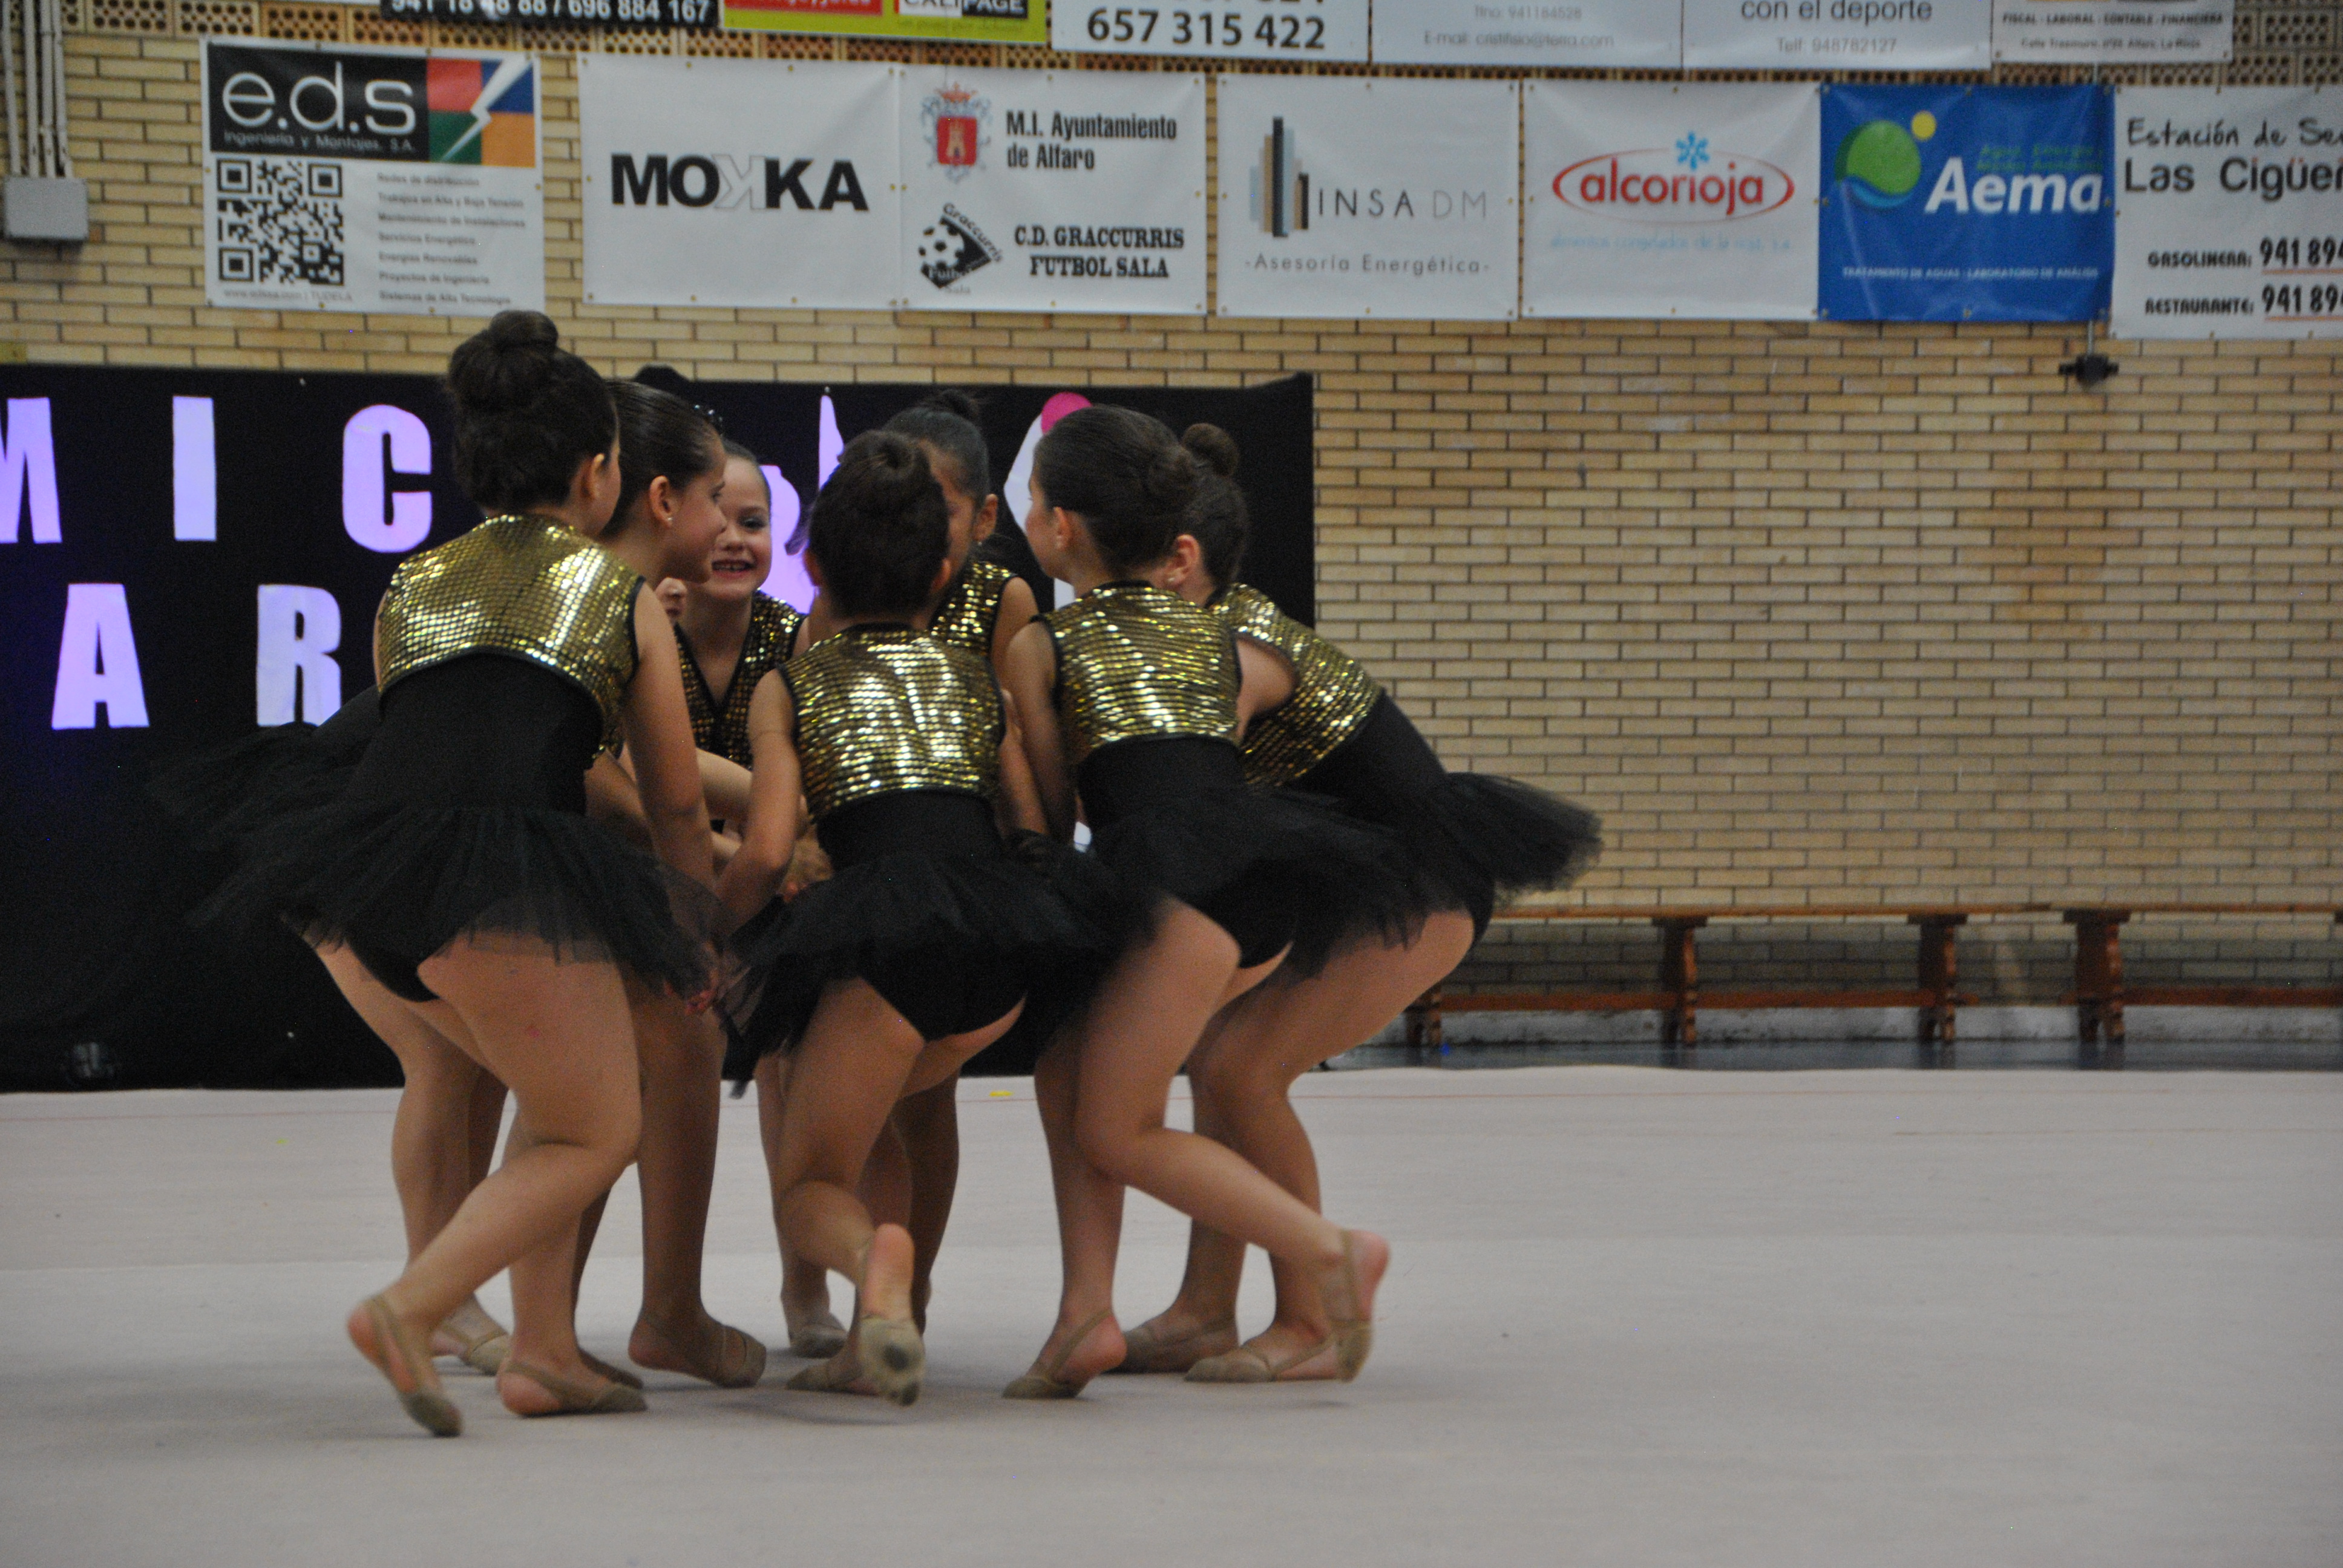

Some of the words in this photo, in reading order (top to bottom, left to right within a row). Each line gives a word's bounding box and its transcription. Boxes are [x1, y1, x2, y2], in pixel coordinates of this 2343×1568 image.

[618, 0, 660, 22] 884
[668, 0, 710, 23] 167
[1741, 0, 1788, 20] con
[1798, 0, 1820, 20] el
[1830, 0, 1933, 25] deporte
[2002, 13, 2036, 24] FISCAL
[1088, 8, 1159, 42] 657
[1173, 11, 1242, 46] 315
[1254, 15, 1325, 50] 422
[222, 60, 416, 136] e.d.s
[1006, 111, 1043, 137] M.I.
[1052, 112, 1177, 141] Ayuntamiento
[2127, 117, 2240, 146] Estación
[2253, 119, 2287, 146] de
[2299, 117, 2343, 146] Se
[1008, 143, 1029, 168] de
[1036, 144, 1095, 169] Alfaro
[1580, 155, 1763, 216] alcorioja
[1924, 156, 2103, 214] Aema
[2125, 156, 2195, 193] Las
[1319, 188, 1415, 218] INSA
[1432, 190, 1486, 219] DM
[1014, 224, 1049, 247] C.D.
[1054, 225, 1184, 249] GRACCURRIS
[2259, 236, 2299, 267] 941
[1030, 255, 1113, 277] FUTBOL
[1116, 255, 1169, 278] SALA
[2262, 283, 2302, 313] 941
[2310, 283, 2343, 313] 89
